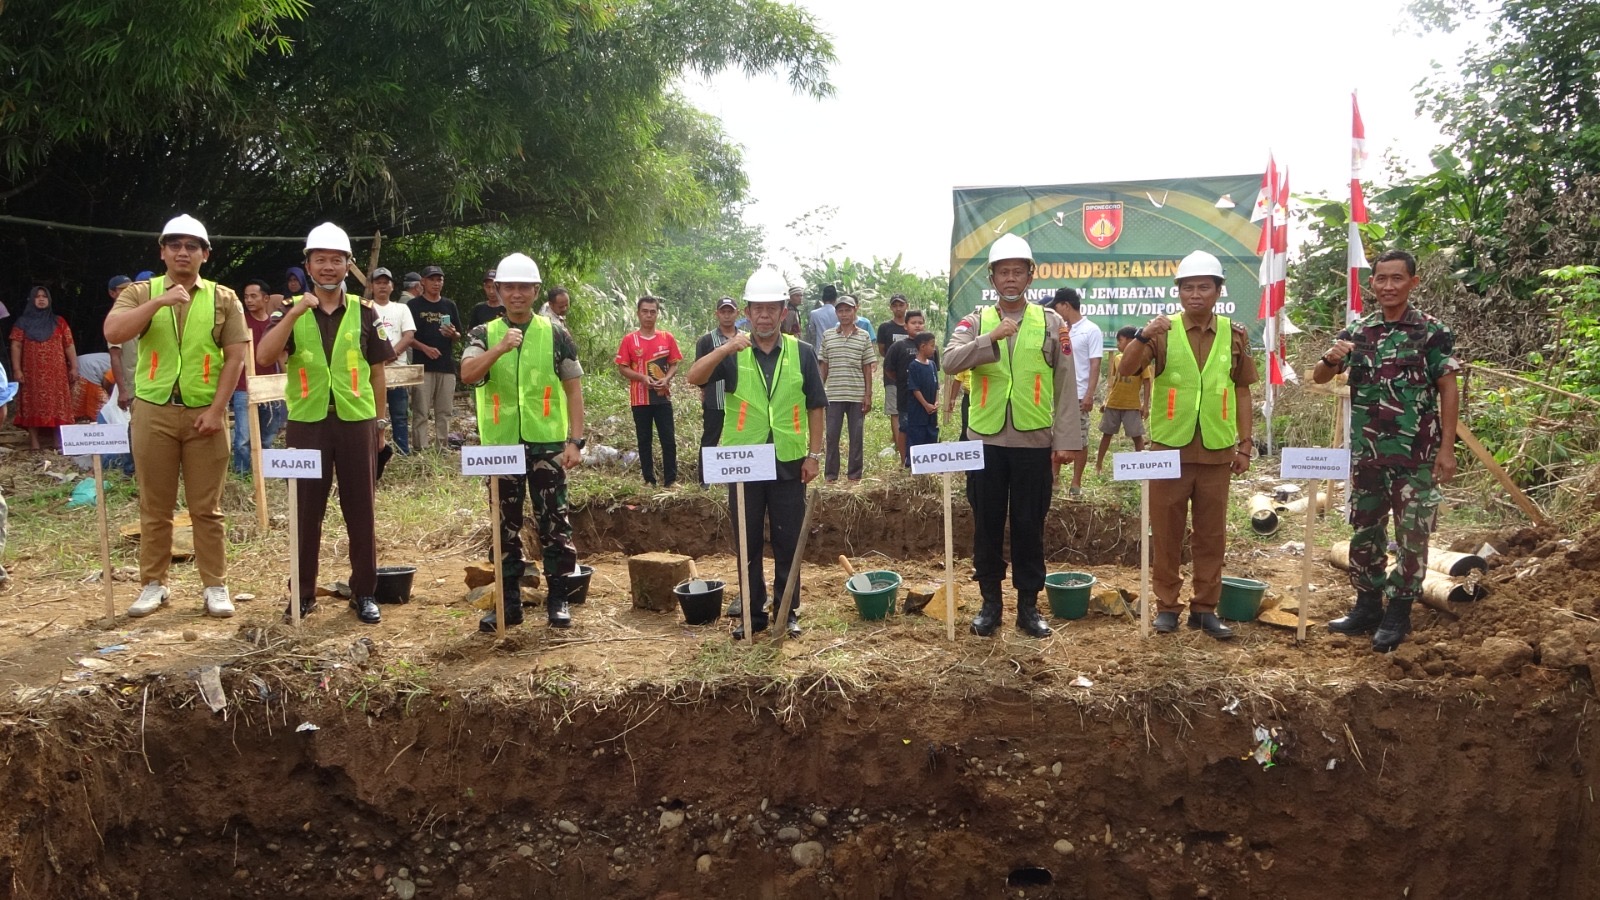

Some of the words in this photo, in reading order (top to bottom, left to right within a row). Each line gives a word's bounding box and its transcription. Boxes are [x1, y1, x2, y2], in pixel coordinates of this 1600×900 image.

[1030, 260, 1182, 279] ROUNDBREAKIN
[1089, 286, 1166, 300] JEMBATAN
[1078, 303, 1119, 316] ODAM
[467, 455, 518, 466] DANDIM
[716, 450, 754, 460] KETUA
[912, 450, 981, 465] KAPOLRES
[271, 459, 316, 469] KAJARI
[1120, 461, 1172, 471] PLT.BUPATI
[721, 466, 751, 476] DPRD
